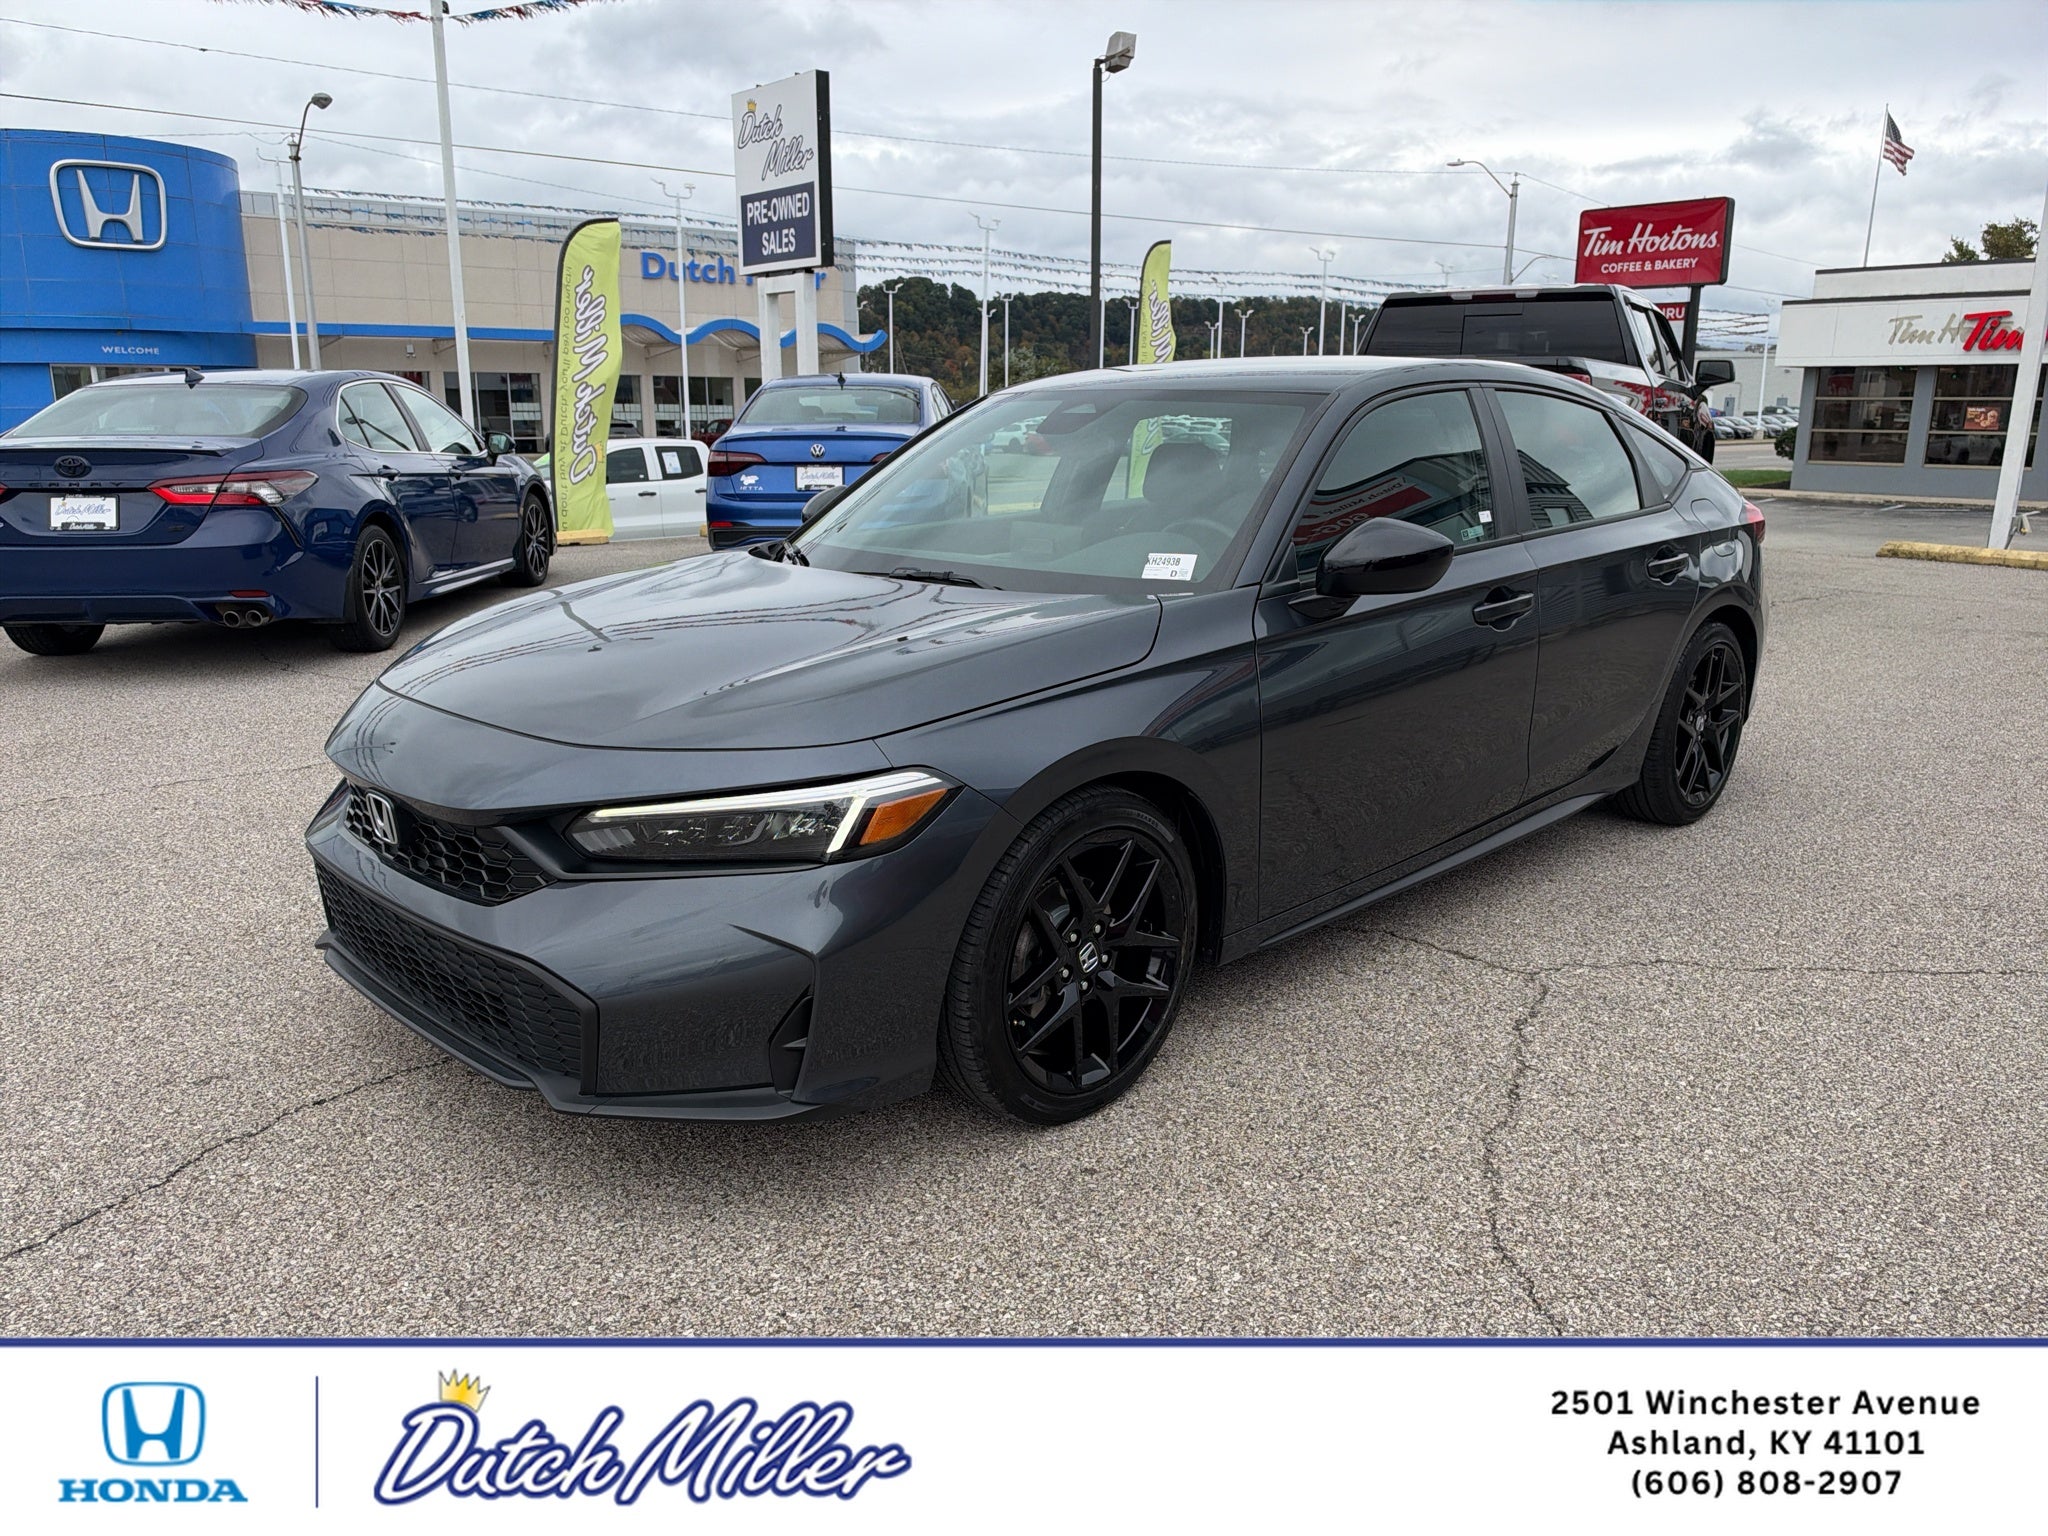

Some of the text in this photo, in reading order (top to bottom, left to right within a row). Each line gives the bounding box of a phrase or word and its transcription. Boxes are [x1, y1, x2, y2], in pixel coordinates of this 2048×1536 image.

[738, 104, 783, 149] Dutch
[761, 134, 814, 181] Miller
[746, 191, 810, 226] PRE-OWNED
[761, 227, 796, 256] SALES
[1583, 222, 1719, 257] Tim Hortons
[640, 251, 735, 285] Dutch
[1601, 257, 1699, 274] COFFEE & BAKERY
[1962, 310, 2026, 352] Tim
[101, 346, 160, 355] WELCOME
